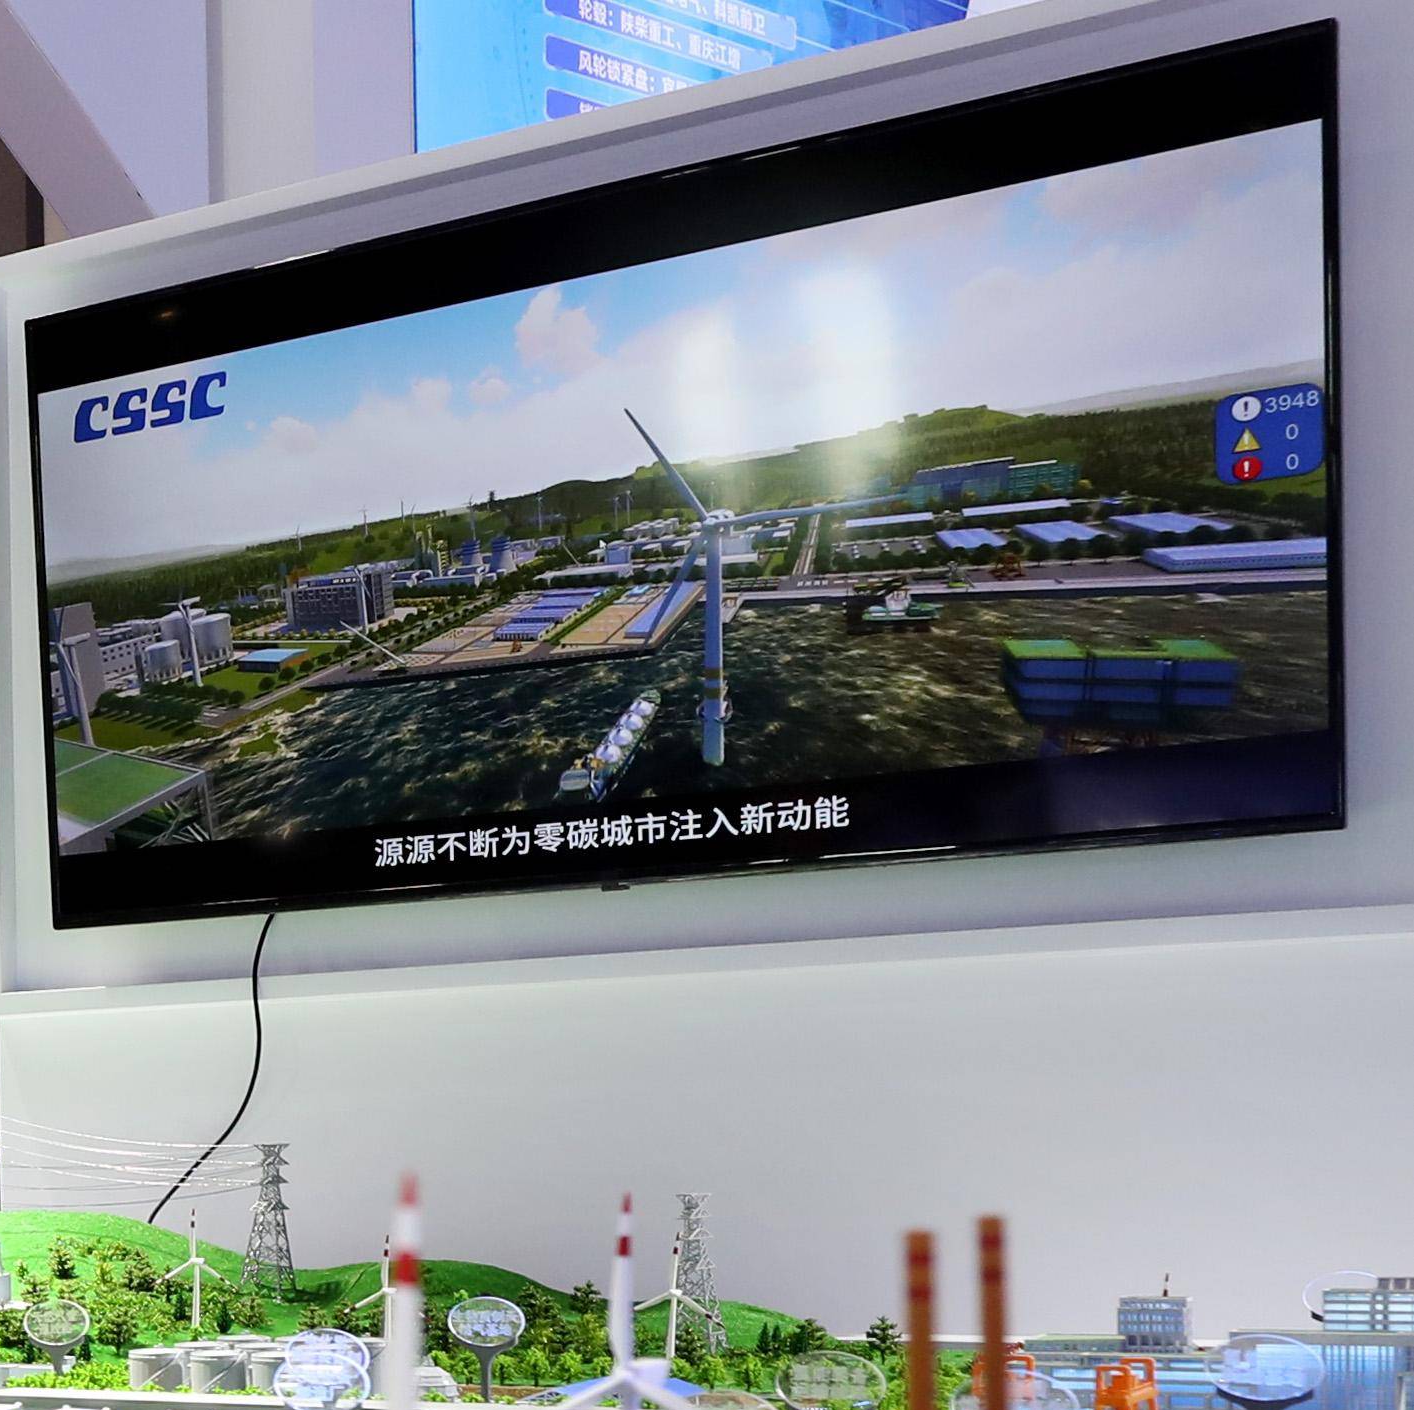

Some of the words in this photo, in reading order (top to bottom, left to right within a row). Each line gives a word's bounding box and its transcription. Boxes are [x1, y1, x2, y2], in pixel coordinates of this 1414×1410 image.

[74, 371, 227, 443] CSSC
[1265, 390, 1319, 413] 3948
[374, 795, 850, 868] 源源不断为零碳城市注入新动能
